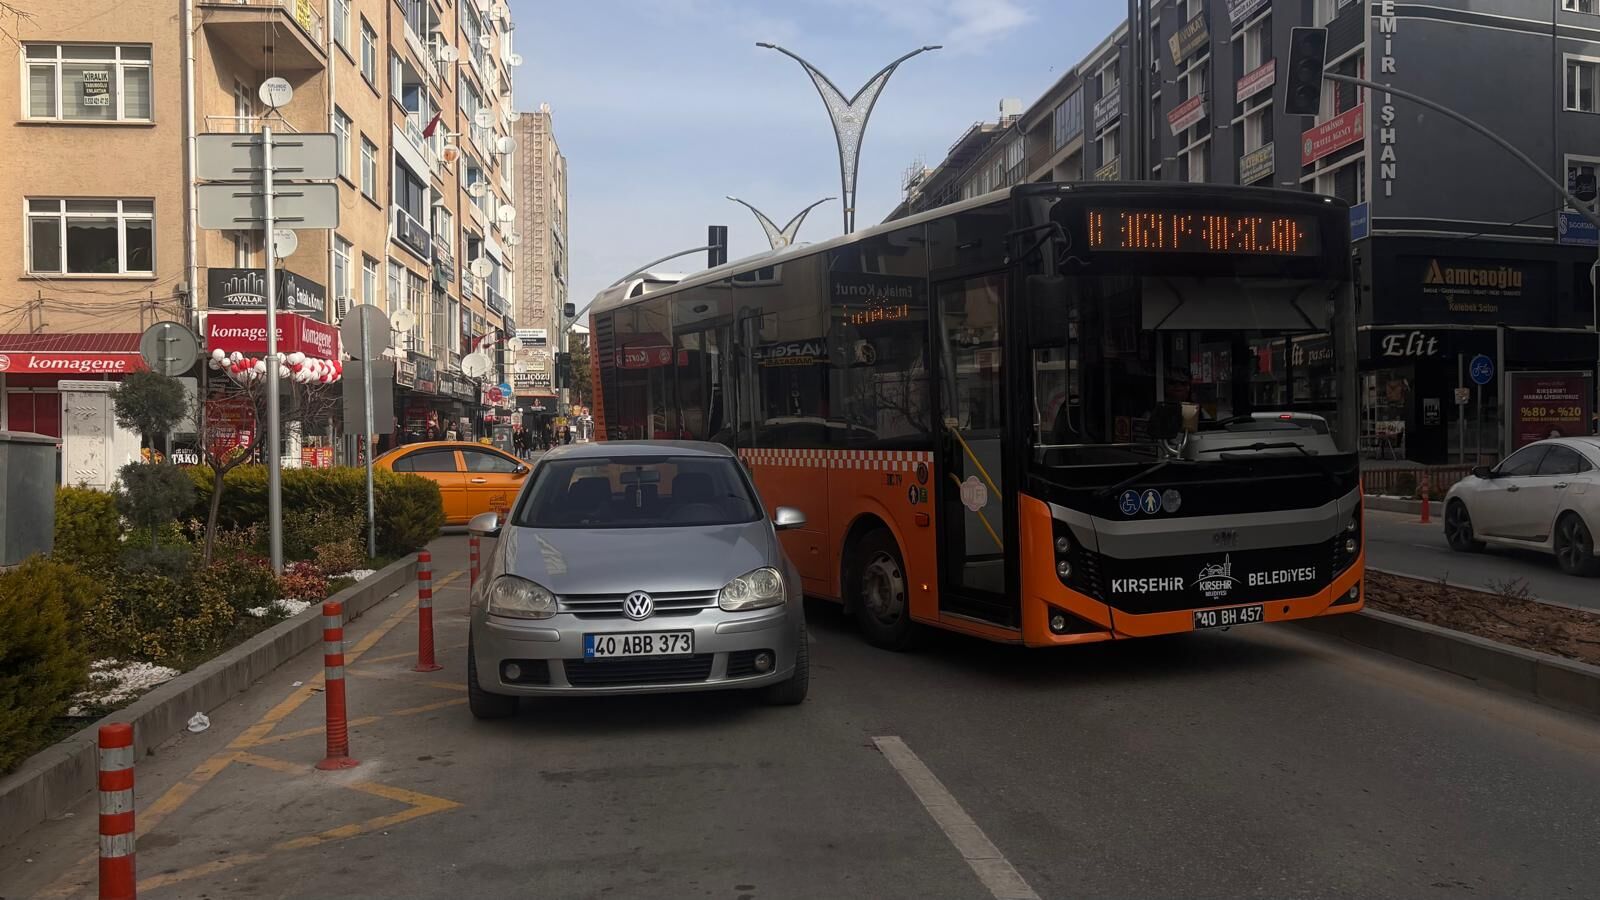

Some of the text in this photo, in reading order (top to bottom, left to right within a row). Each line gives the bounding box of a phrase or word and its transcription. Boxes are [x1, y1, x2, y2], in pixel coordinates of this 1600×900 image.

[211, 324, 283, 342] komagee
[302, 318, 332, 353] komagene
[1382, 331, 1439, 356] Elit
[28, 355, 126, 372] komagene
[1521, 407, 1546, 417] %80
[1557, 407, 1582, 417] %20
[171, 453, 199, 465] TAKO
[1112, 577, 1184, 594] KIRŞEHİR
[1248, 566, 1317, 587] BELEDİYESİ
[1201, 606, 1262, 627] 40 BH 457
[596, 637, 616, 655] 40
[622, 635, 654, 655] ABB
[659, 633, 691, 653] 373
